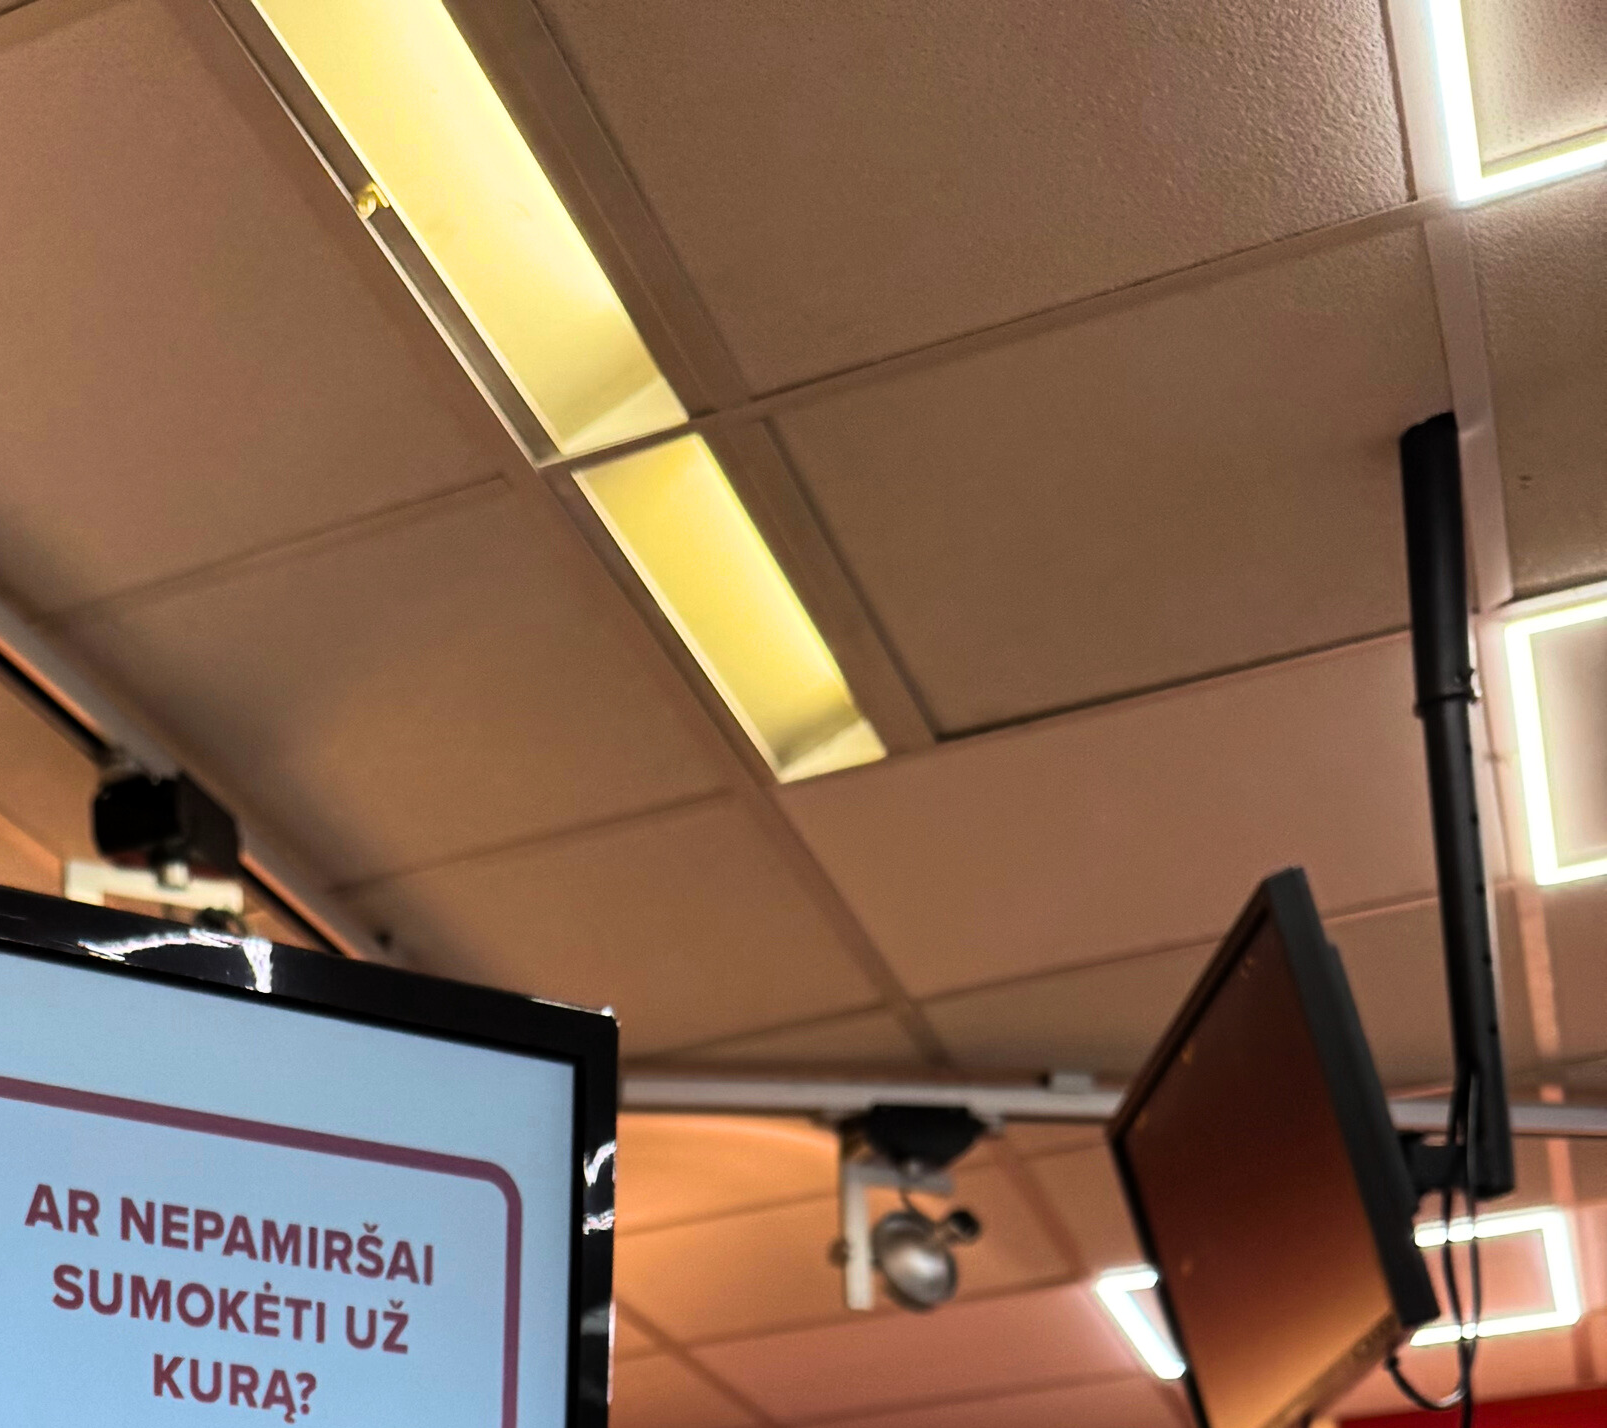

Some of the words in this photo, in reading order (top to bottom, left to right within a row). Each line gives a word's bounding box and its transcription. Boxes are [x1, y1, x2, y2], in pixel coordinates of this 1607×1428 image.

[24, 1183, 100, 1237] AR
[121, 1196, 434, 1286] NEPAMIRŠAI
[51, 1263, 327, 1344] SUMOKĖTI
[344, 1290, 411, 1355] UŽ
[151, 1353, 318, 1424] KURĄ?
